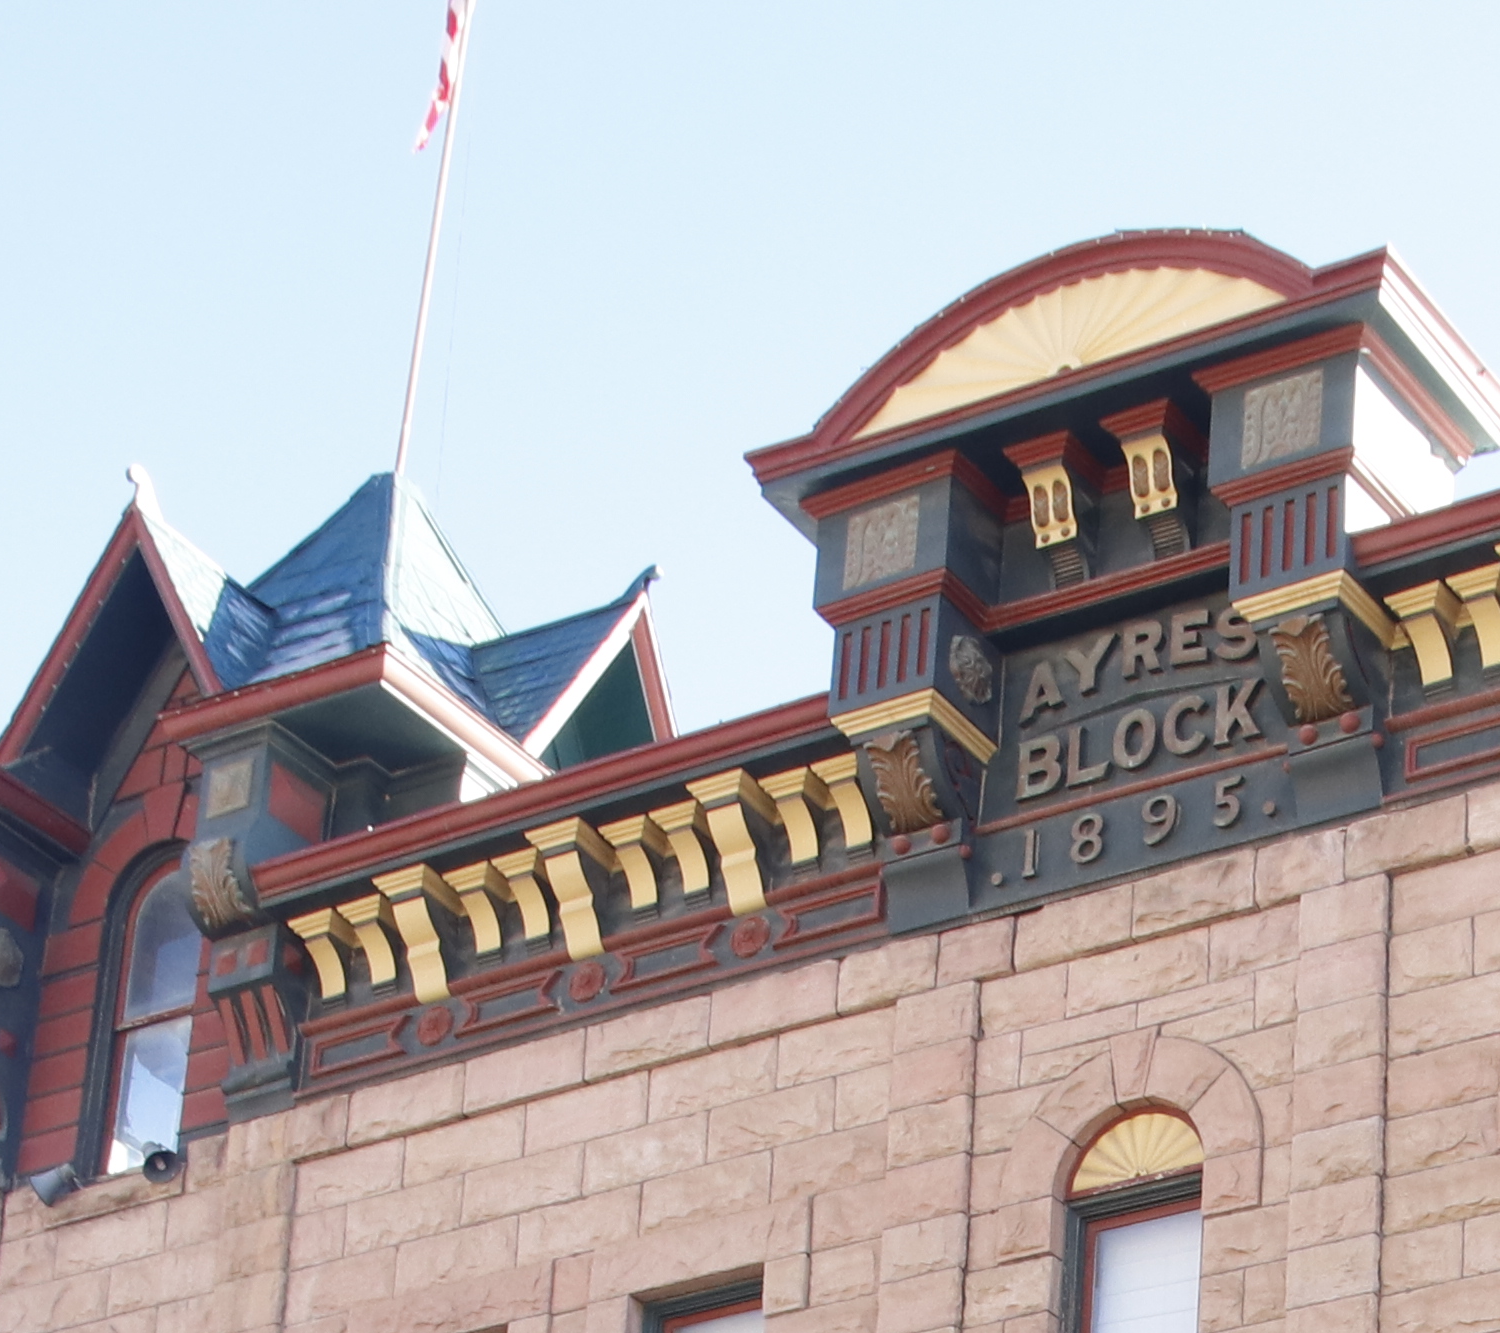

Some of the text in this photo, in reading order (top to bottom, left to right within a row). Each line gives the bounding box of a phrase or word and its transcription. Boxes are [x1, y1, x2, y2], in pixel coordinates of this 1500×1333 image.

[1018, 606, 1259, 727] AYRES
[1014, 676, 1266, 802] BLOCK
[1019, 772, 1248, 880] 1895
